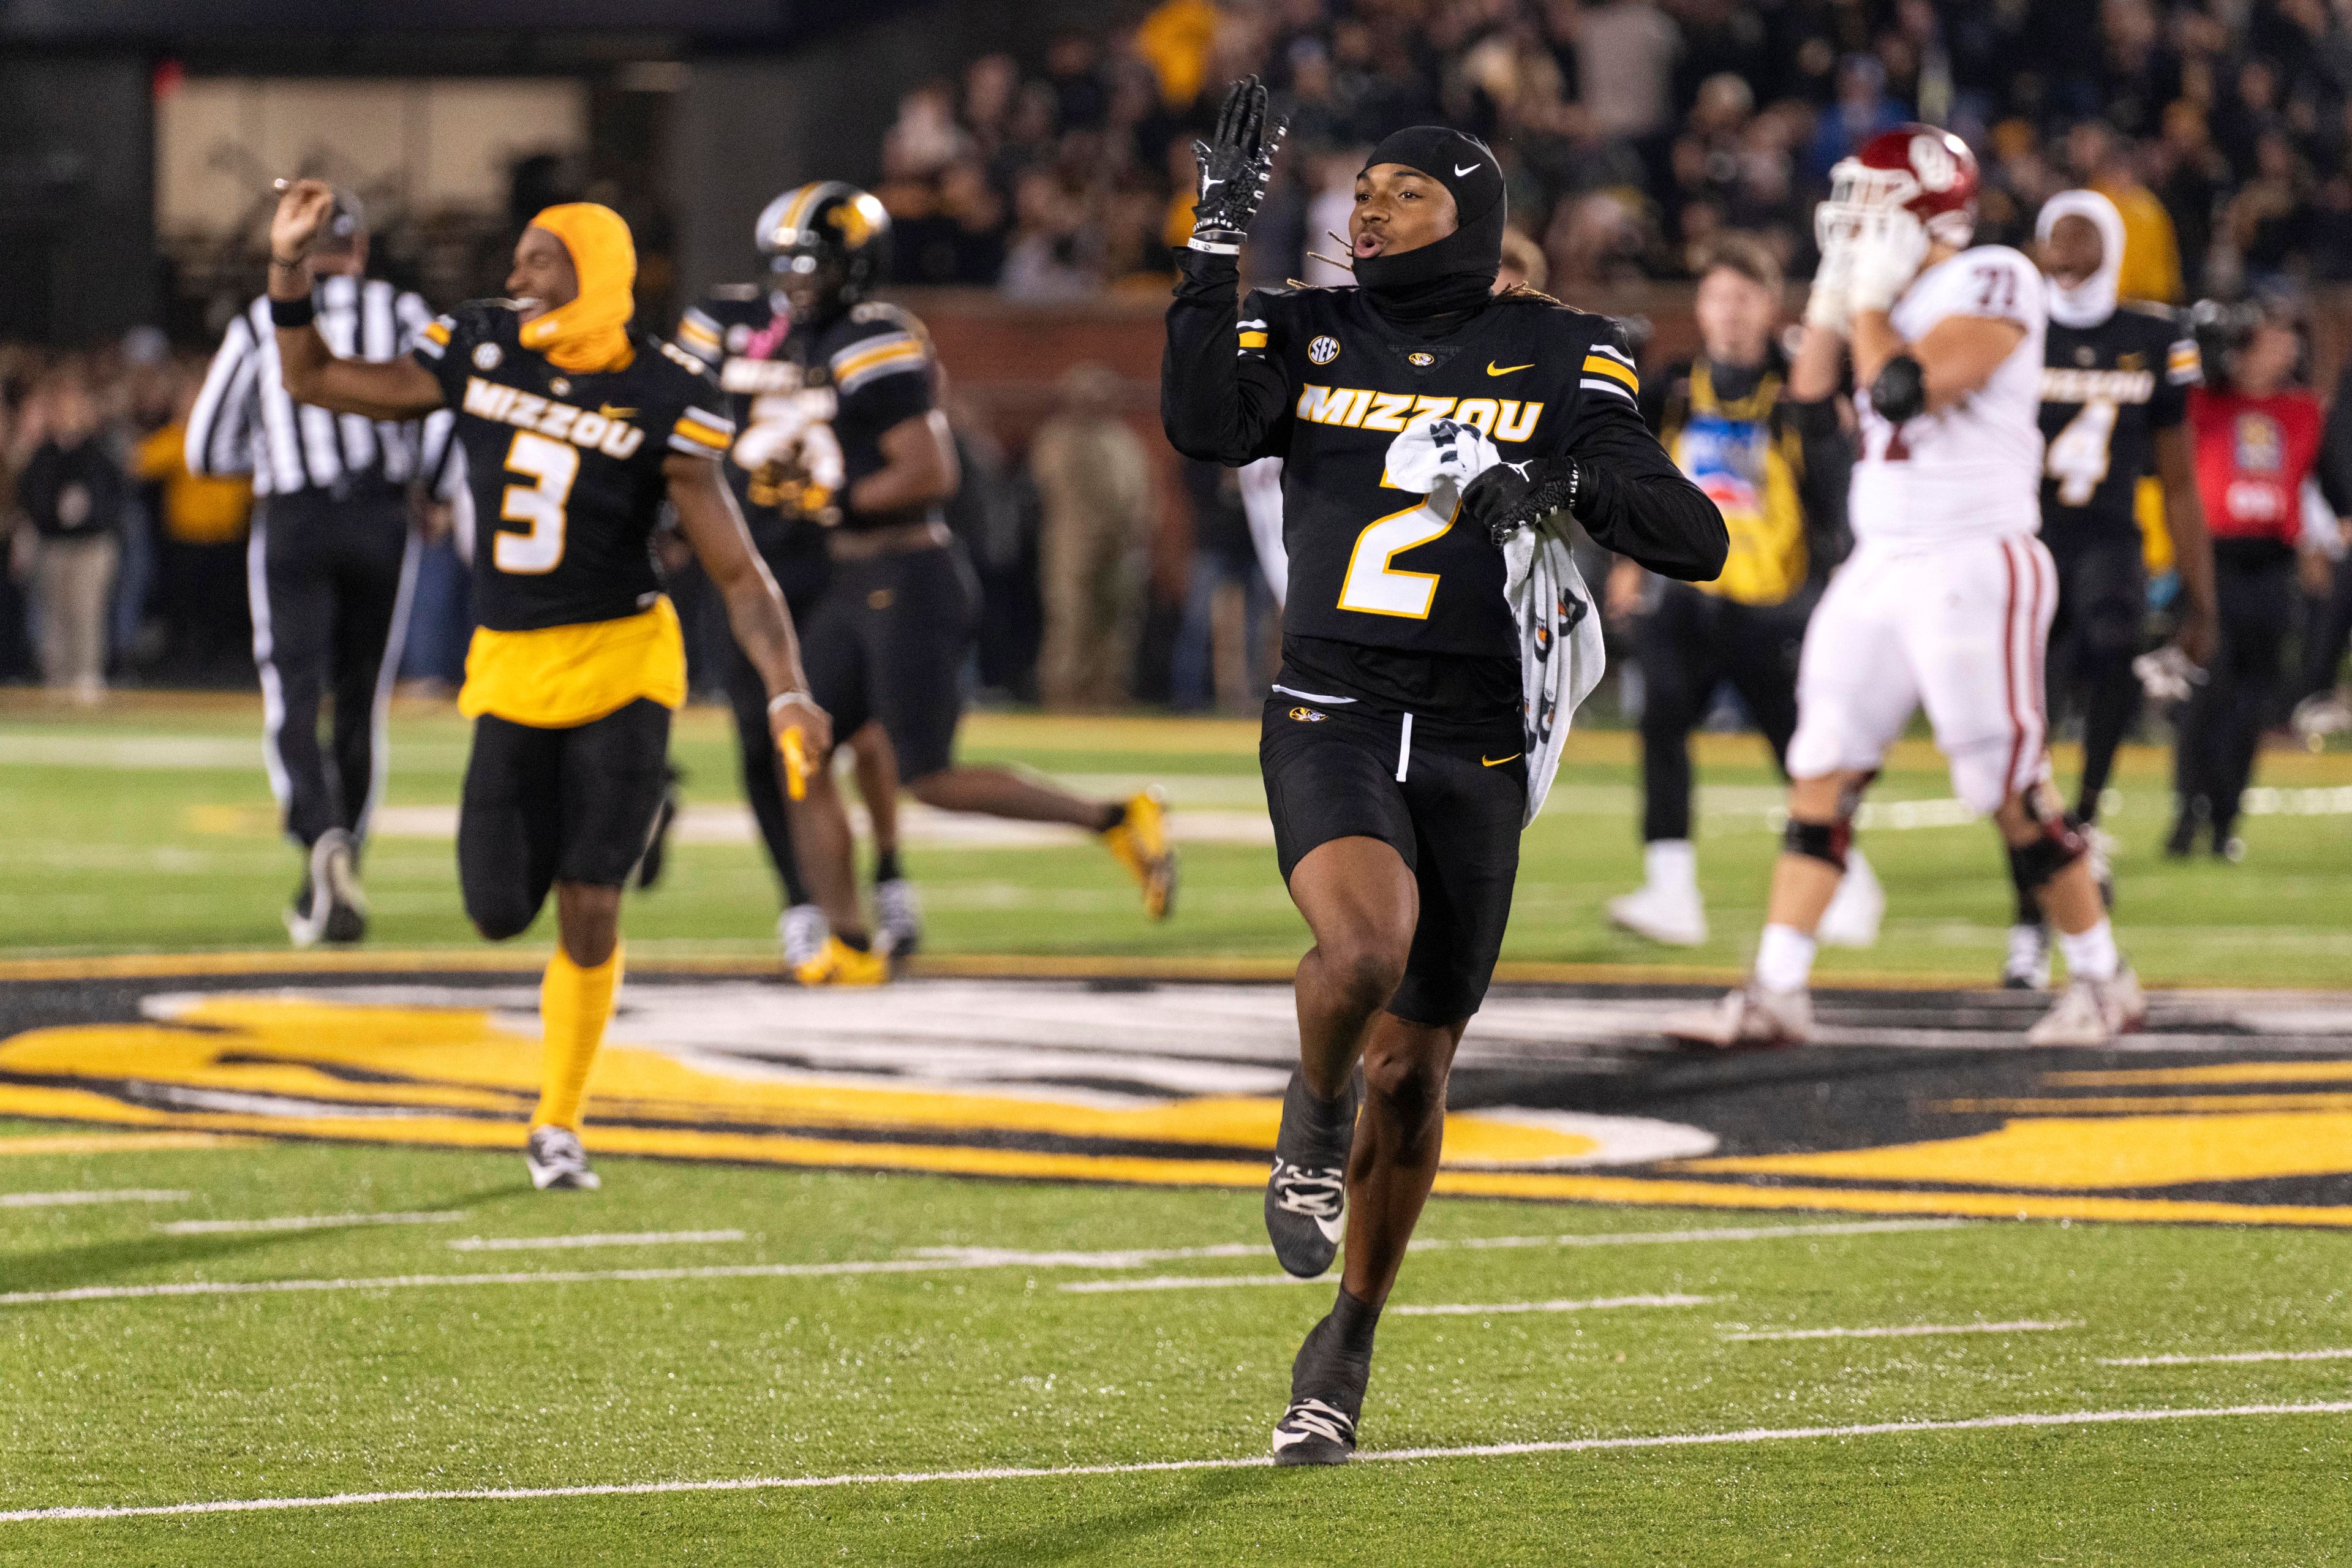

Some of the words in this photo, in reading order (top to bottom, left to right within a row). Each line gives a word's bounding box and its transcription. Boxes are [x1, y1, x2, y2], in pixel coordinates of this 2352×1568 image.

[1972, 265, 2017, 309] 71
[1310, 337, 1338, 363] SEC
[462, 375, 646, 459] MIZZOU
[1296, 382, 1544, 442] MIZZOU
[2045, 398, 2120, 507] 4
[493, 429, 581, 575] 3
[1336, 467, 1463, 620] 2
